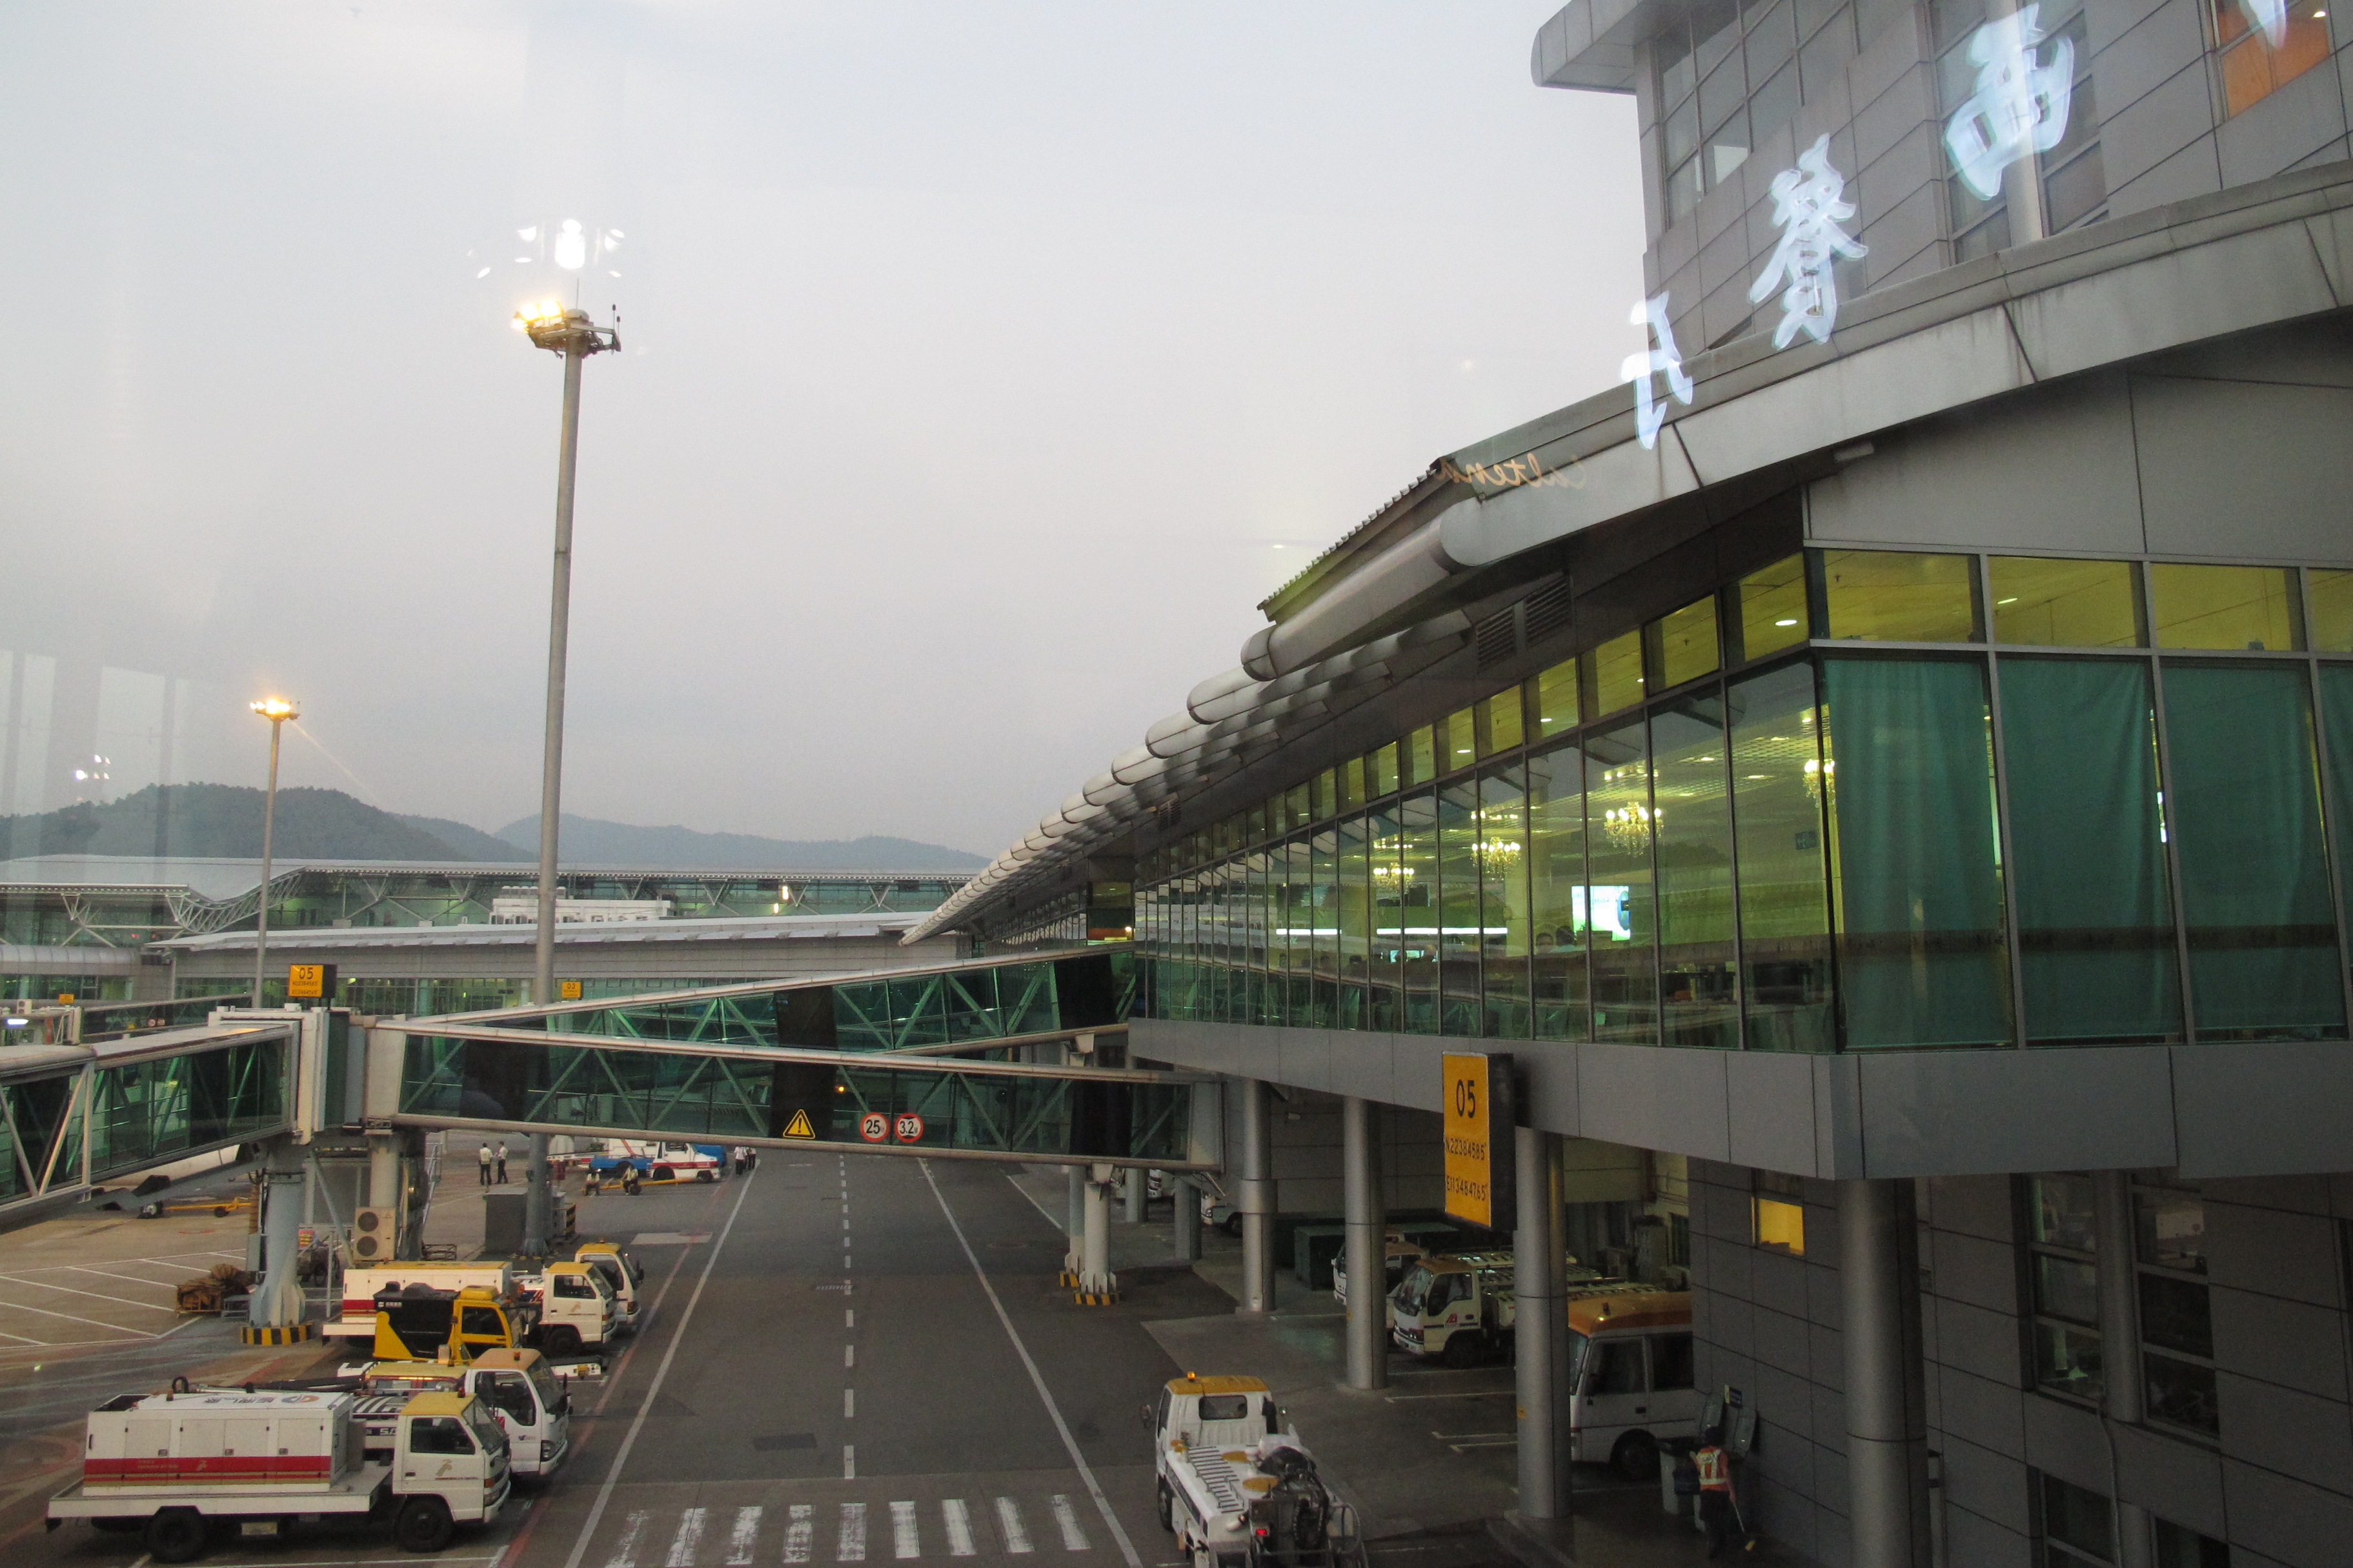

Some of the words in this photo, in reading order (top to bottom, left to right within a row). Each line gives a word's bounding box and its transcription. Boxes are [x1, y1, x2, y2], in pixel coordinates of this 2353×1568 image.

[299, 967, 313, 980] 05
[1456, 1079, 1476, 1118] 05
[865, 1119, 880, 1134] 25
